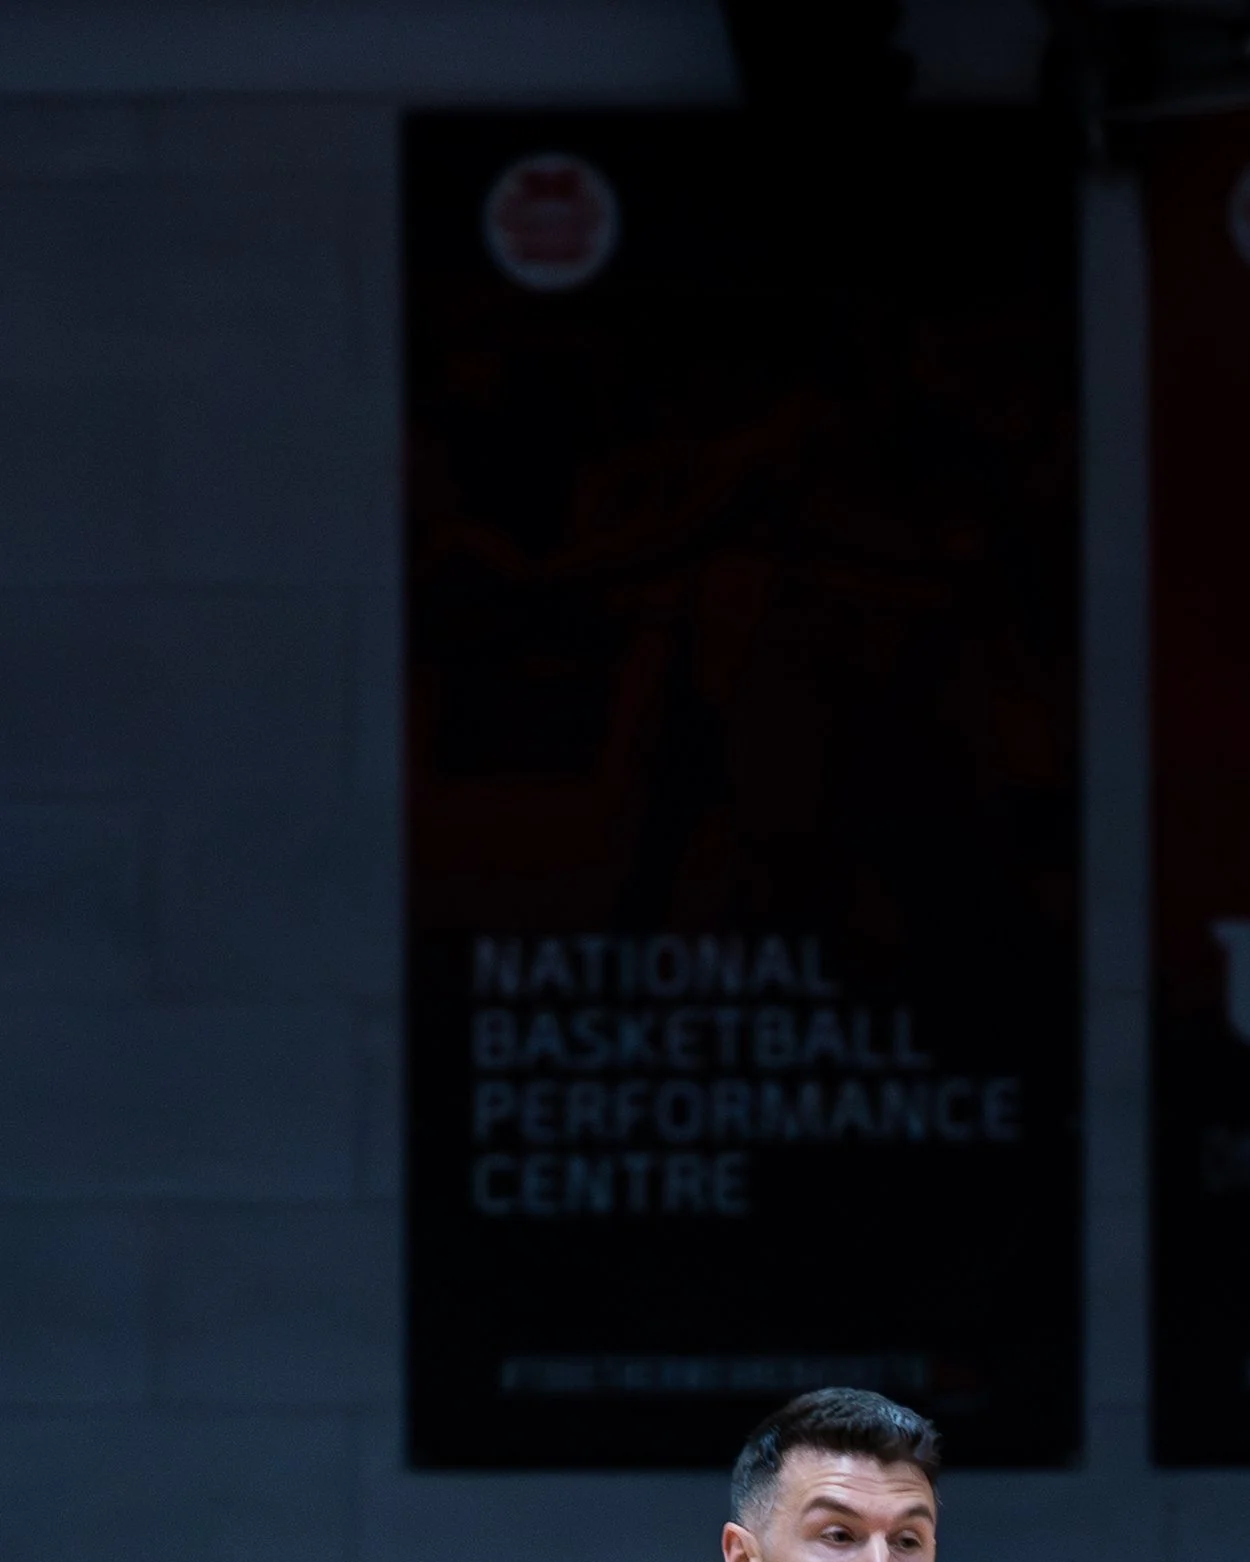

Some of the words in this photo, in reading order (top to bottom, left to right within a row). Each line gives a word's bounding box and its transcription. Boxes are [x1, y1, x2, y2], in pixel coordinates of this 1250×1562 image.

[472, 931, 840, 998] NATIONAL
[470, 1006, 936, 1070] BASKETBALL
[471, 1075, 1022, 1143] PERFORMANCE
[470, 1150, 752, 1218] CENTRE
